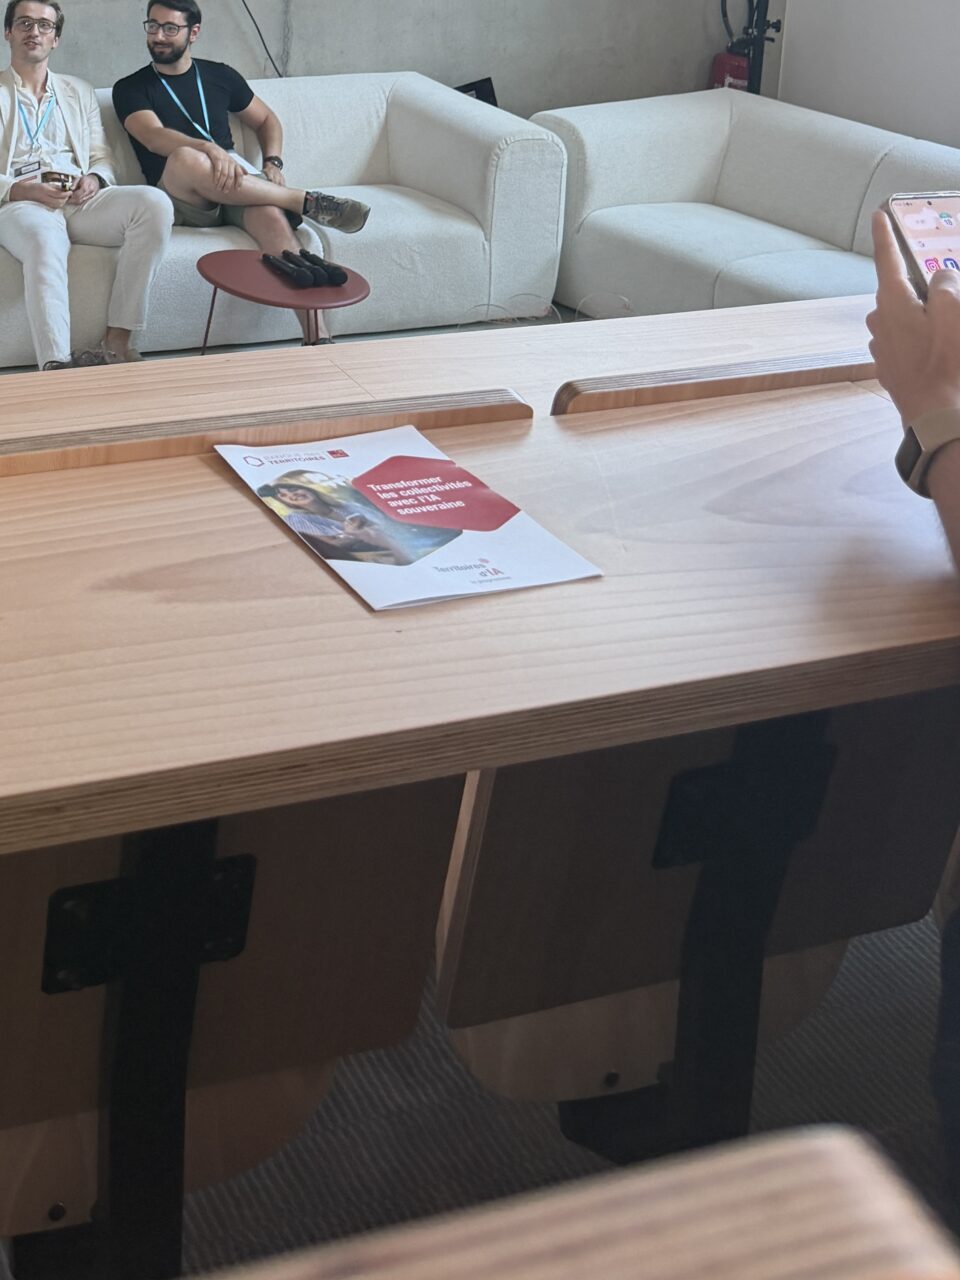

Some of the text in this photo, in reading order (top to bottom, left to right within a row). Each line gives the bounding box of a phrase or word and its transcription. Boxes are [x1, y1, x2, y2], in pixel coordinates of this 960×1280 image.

[366, 476, 442, 492] Transformer
[377, 480, 473, 500] les collectivités
[387, 497, 418, 508] avec
[397, 500, 466, 515] souveraine
